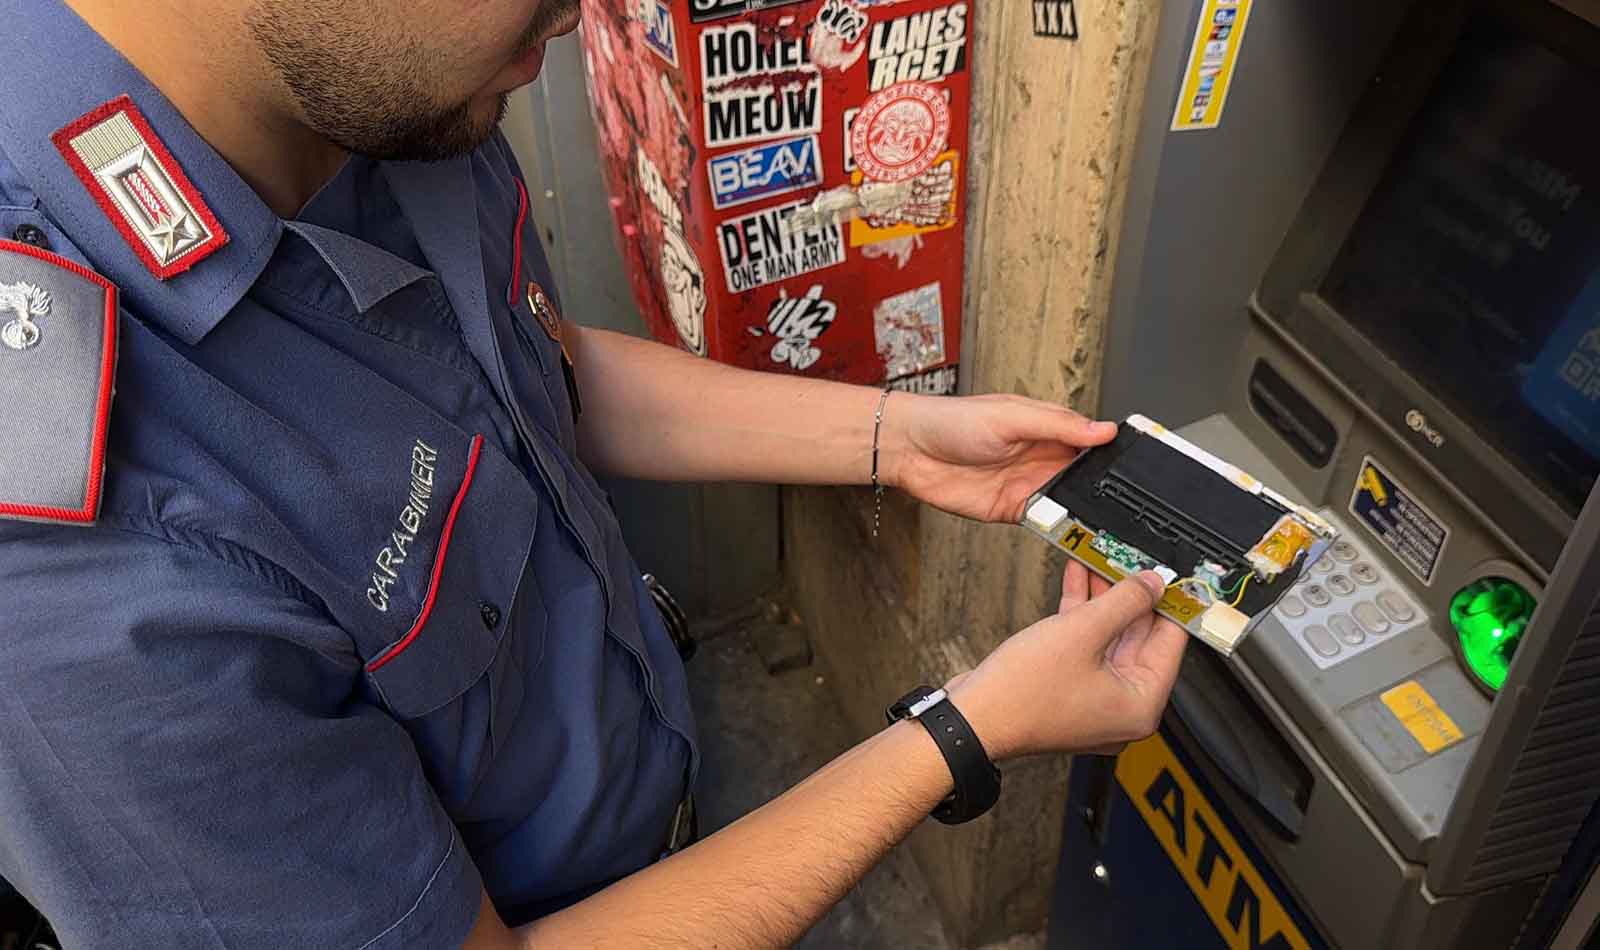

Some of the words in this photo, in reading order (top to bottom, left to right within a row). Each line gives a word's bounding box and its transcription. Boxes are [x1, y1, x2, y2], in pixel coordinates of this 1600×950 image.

[1034, 1, 1074, 36] XXX
[709, 87, 818, 141] MEOW
[731, 263, 762, 291] ONE
[765, 253, 797, 282] MAN
[802, 240, 840, 271] ARMY
[366, 439, 438, 612] CARABINIERI
